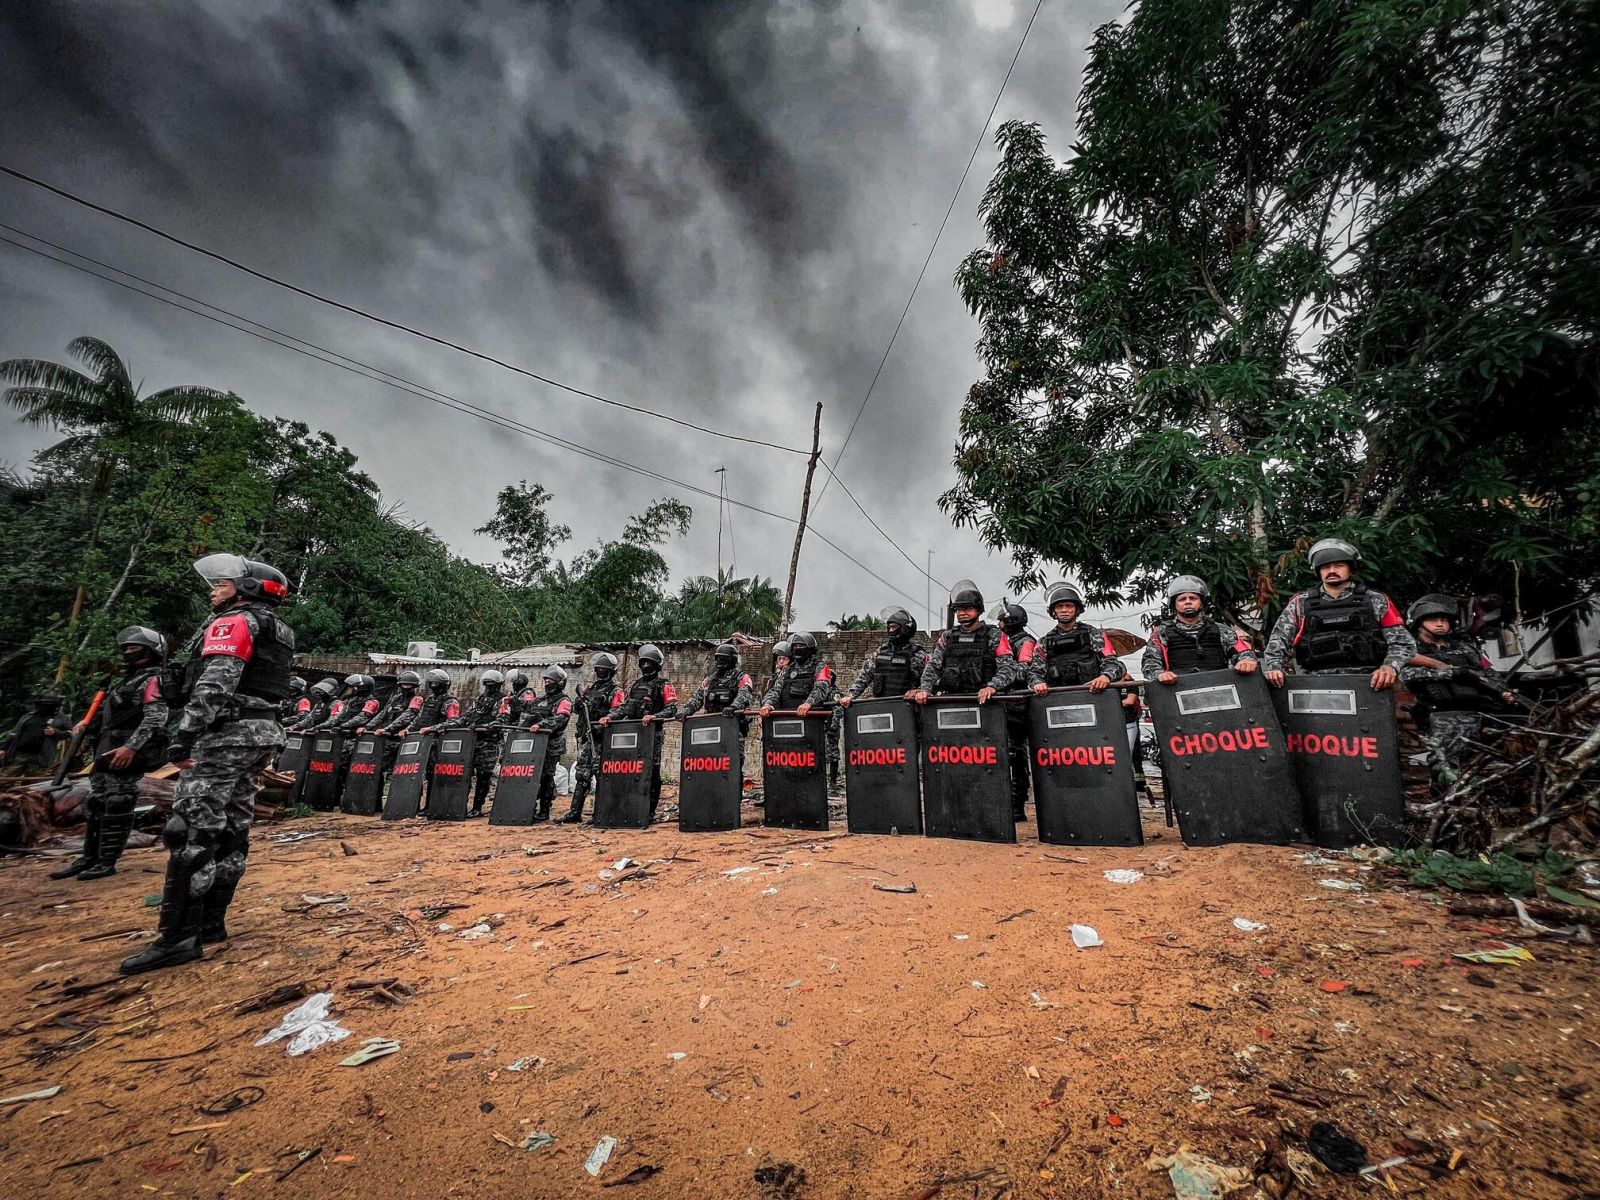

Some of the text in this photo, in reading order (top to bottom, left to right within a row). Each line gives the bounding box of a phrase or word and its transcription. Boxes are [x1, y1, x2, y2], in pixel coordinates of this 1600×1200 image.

[1169, 726, 1270, 757] CHOQUE
[1286, 733, 1379, 759] HOQUE
[765, 751, 816, 768] CHOQUE
[849, 747, 907, 766] CHOQUE
[927, 744, 998, 765] CHOQUE
[1036, 745, 1117, 767] CHOQUE
[434, 763, 465, 776] CHOQUE
[500, 764, 535, 777] CHOQUE
[602, 760, 644, 775] CHOQUE
[683, 756, 731, 772] CHOQUE
